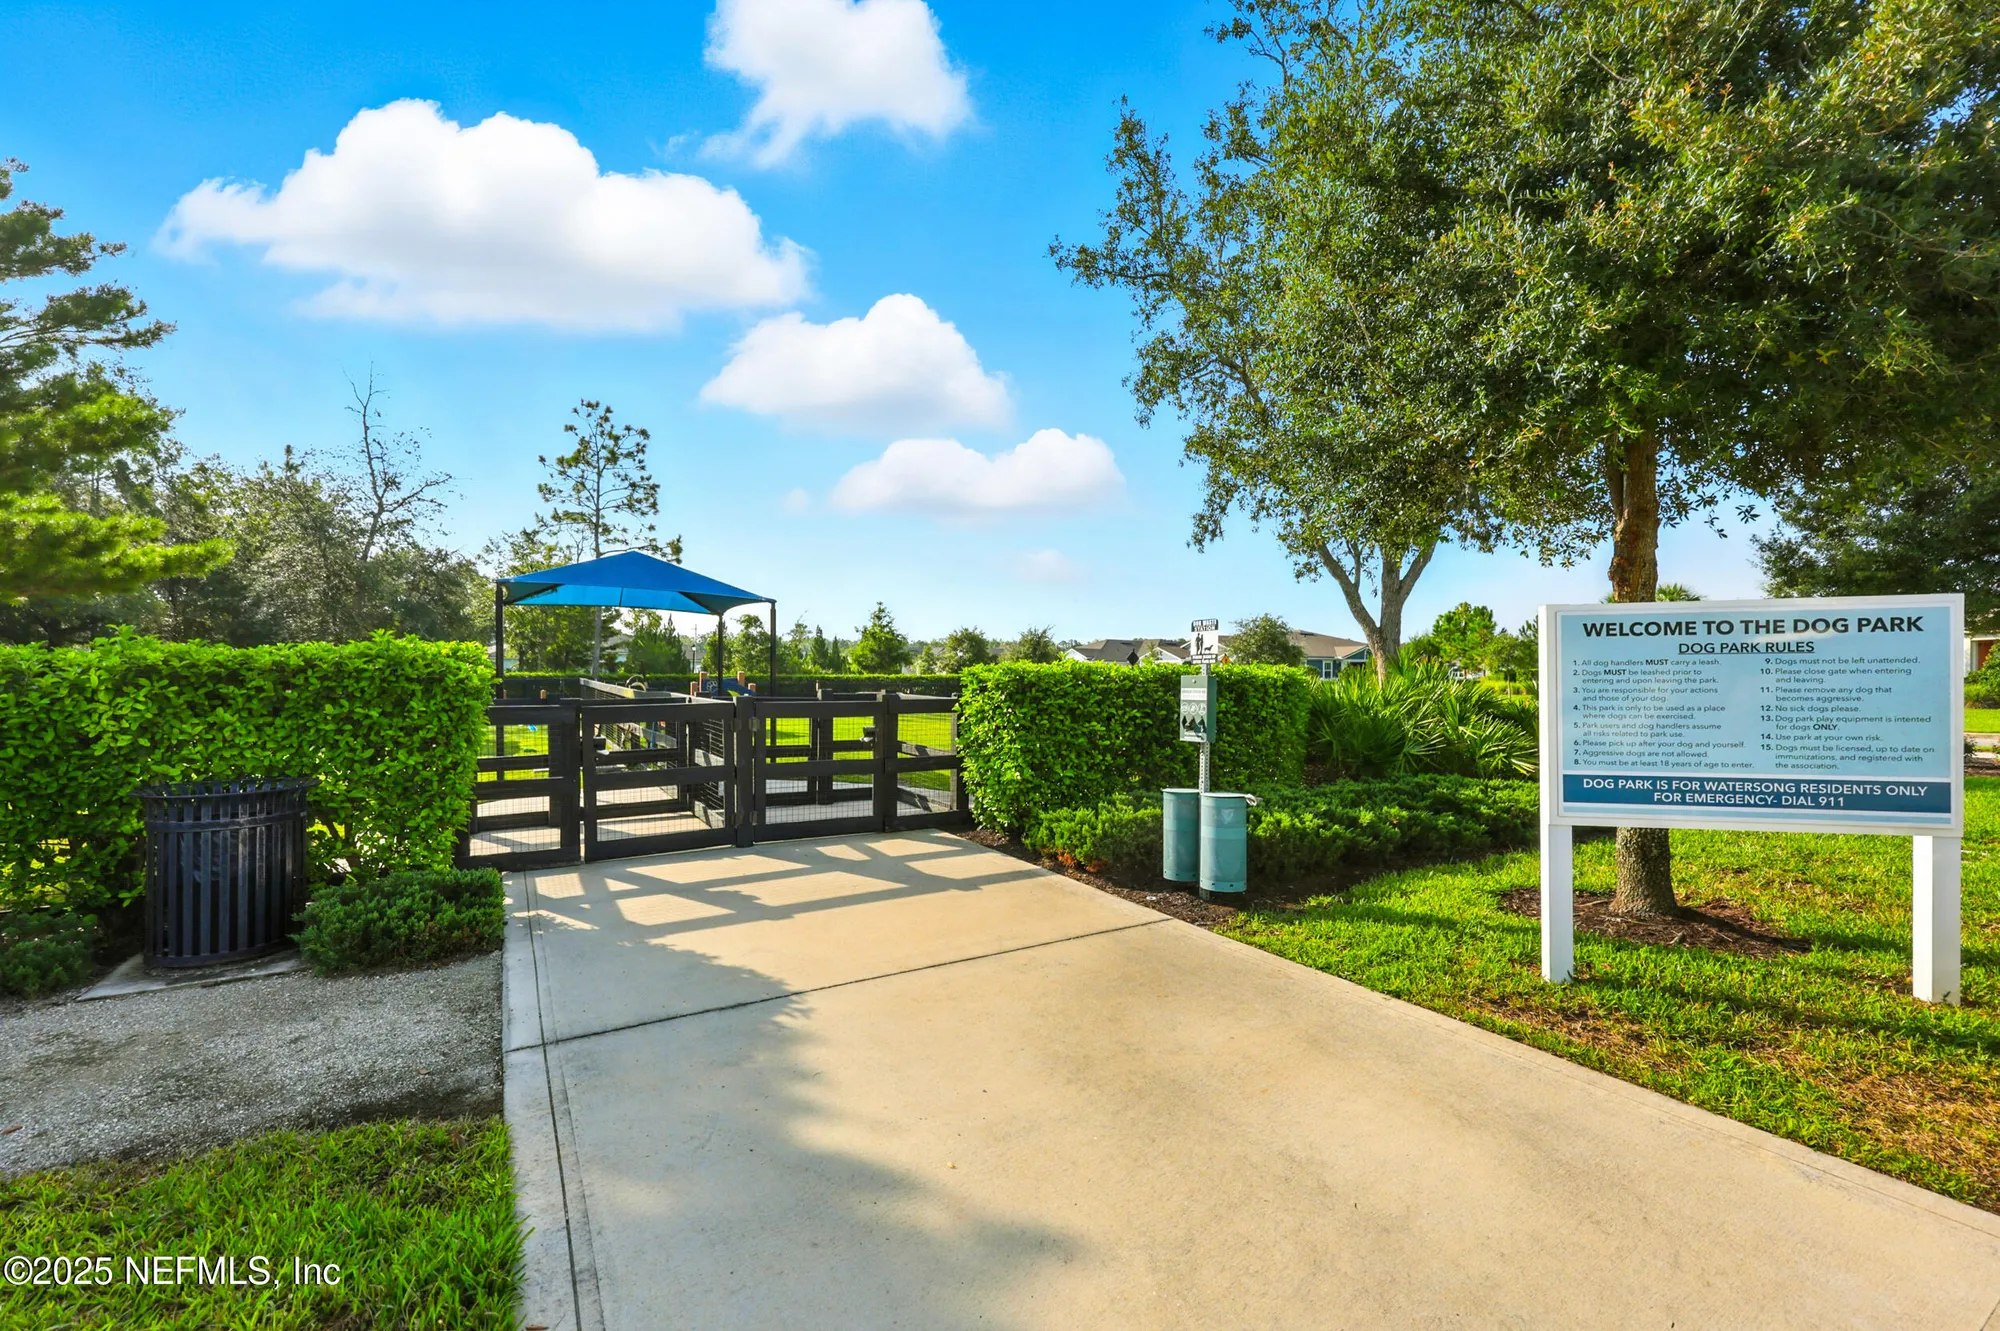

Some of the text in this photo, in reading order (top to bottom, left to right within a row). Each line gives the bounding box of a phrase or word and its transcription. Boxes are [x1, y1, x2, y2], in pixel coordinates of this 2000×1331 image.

[1583, 616, 1923, 637] WELCOME TO THE DOG PARK
[1679, 641, 1814, 654] DOG PARK RULES
[1593, 659, 1609, 668] dog
[1775, 658, 1797, 666] Dogs
[1582, 669, 1602, 677] Dogs
[1673, 669, 1692, 677] prior
[1828, 668, 1847, 676] gate
[1874, 668, 1912, 676] entering
[1794, 677, 1826, 685] leaving.
[1611, 687, 1656, 695] responsible
[1855, 687, 1873, 695] dog
[1650, 695, 1668, 703] dog.
[1816, 695, 1864, 703] aggressive.
[1598, 704, 1616, 712] park
[1625, 704, 1641, 713] only
[1704, 705, 1725, 713] place
[1807, 705, 1829, 714] dogs
[1831, 706, 1861, 714] please.
[1775, 715, 1793, 724] Dog
[1796, 715, 1814, 724] park
[1816, 716, 1834, 724] play
[1836, 716, 1883, 724] equipment
[1790, 724, 1810, 732] dogs
[1793, 734, 1811, 742] park
[1608, 740, 1624, 748] pick
[1677, 741, 1693, 749] dog
[1712, 741, 1746, 750] yourself.
[1776, 744, 1798, 753] Dogs
[1836, 745, 1873, 754] licensed,
[1583, 749, 1624, 758] Aggressive
[1626, 750, 1645, 758] dogs
[1775, 754, 1837, 763] immunizations,
[1858, 755, 1902, 763] registered
[1583, 778, 1927, 796] DOG PARK IS FOR WATERSONG RESIDENTS ONLY
[1654, 792, 1843, 806] FOR EMERGENCY- DIAL 911
